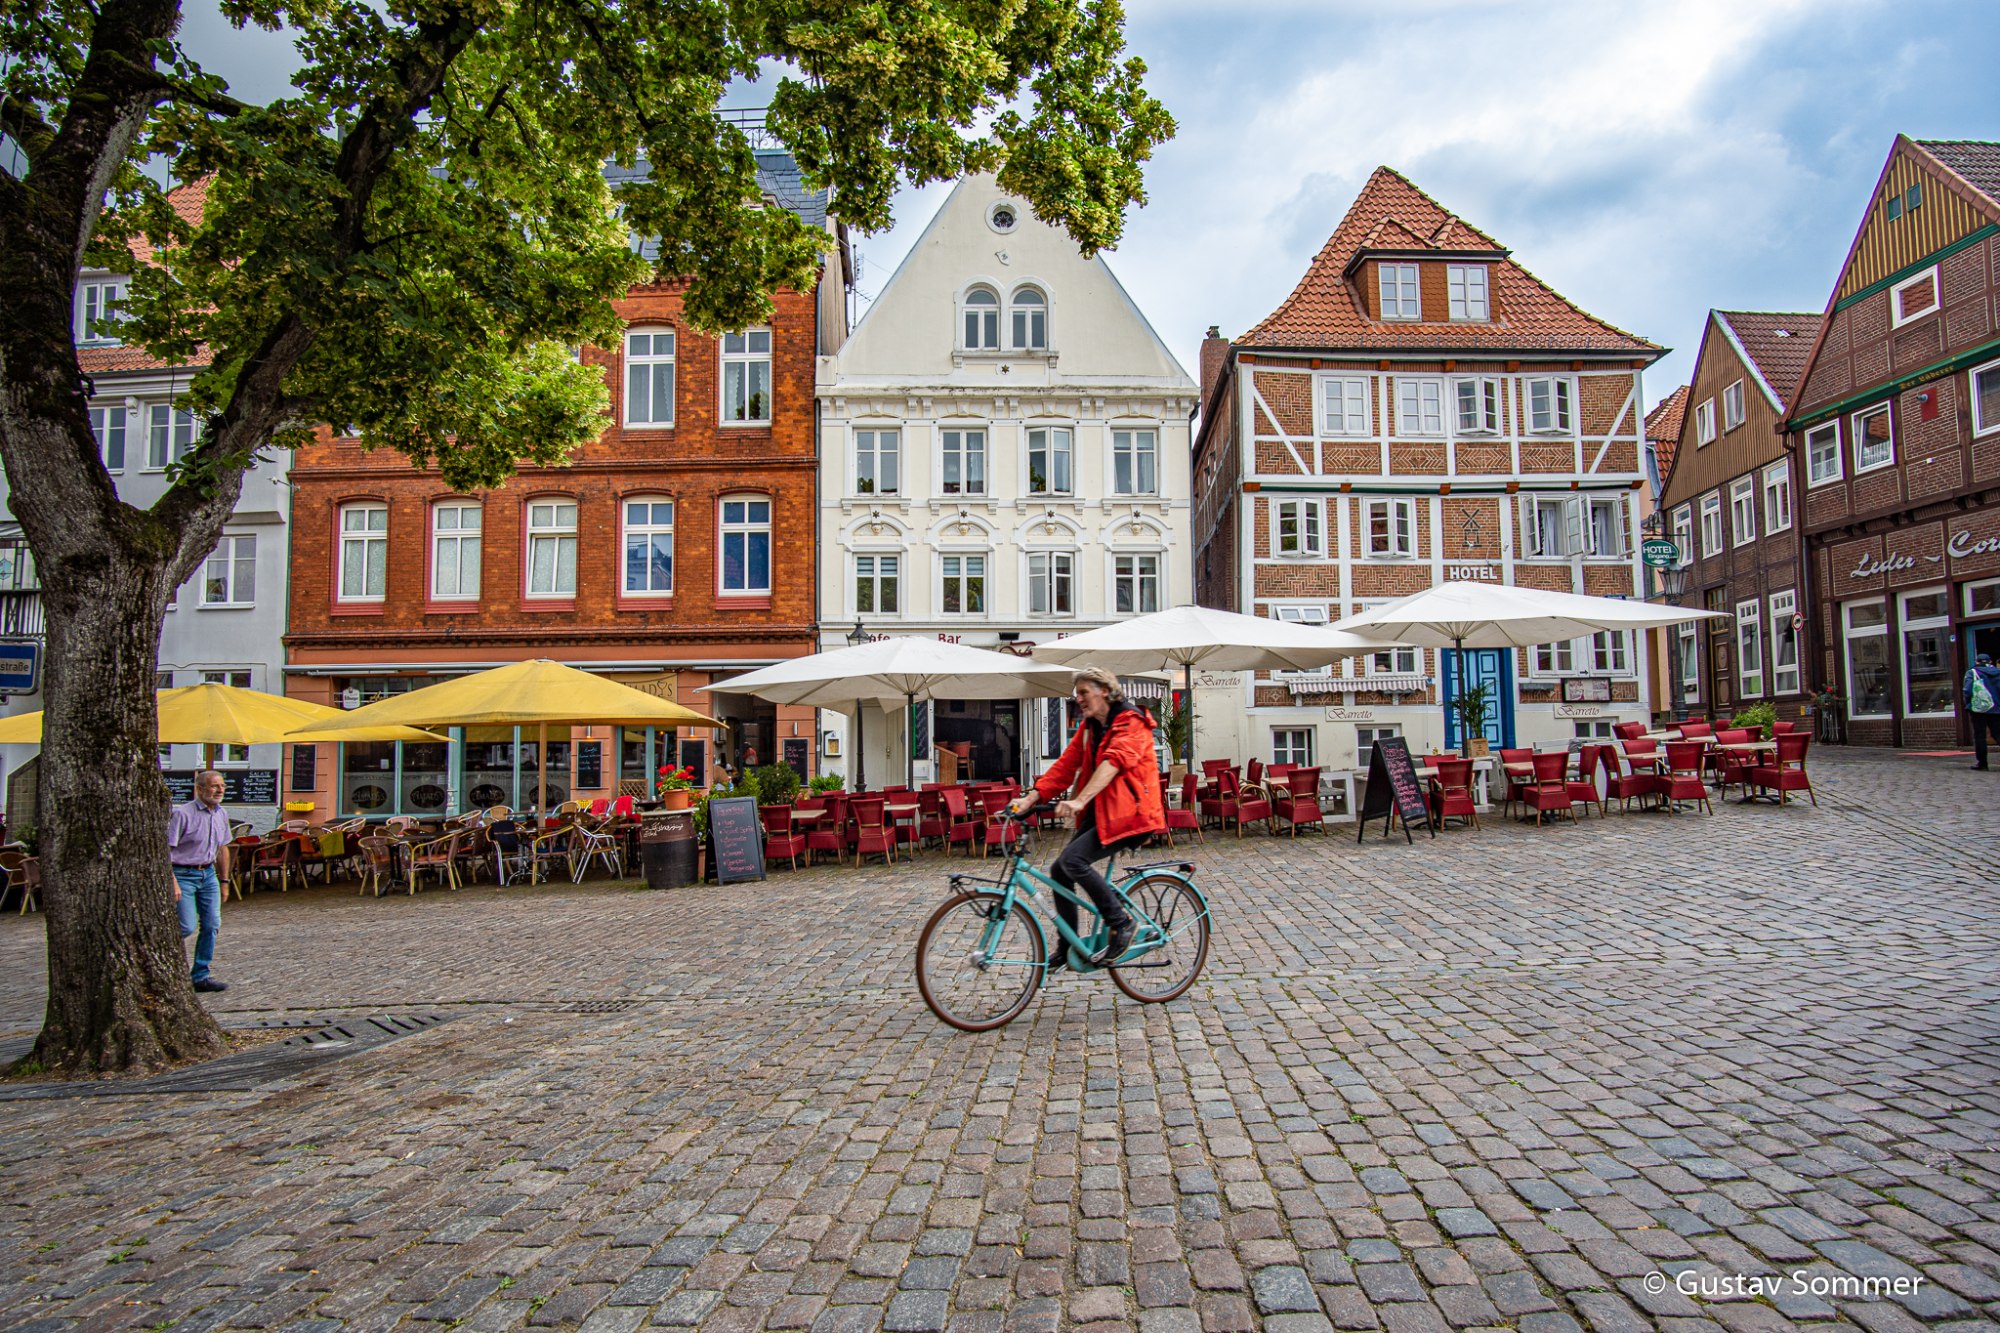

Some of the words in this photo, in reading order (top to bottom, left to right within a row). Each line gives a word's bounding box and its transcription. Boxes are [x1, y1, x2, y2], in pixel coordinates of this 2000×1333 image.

[1850, 552, 1915, 578] Leder
[1449, 566, 1498, 580] HOTEL
[866, 633, 891, 643] afe
[937, 633, 961, 645] Bar
[0, 661, 29, 672] straße
[1196, 674, 1241, 687] Barretto
[1328, 707, 1373, 719] Barretto
[1558, 704, 1600, 717] Barretto
